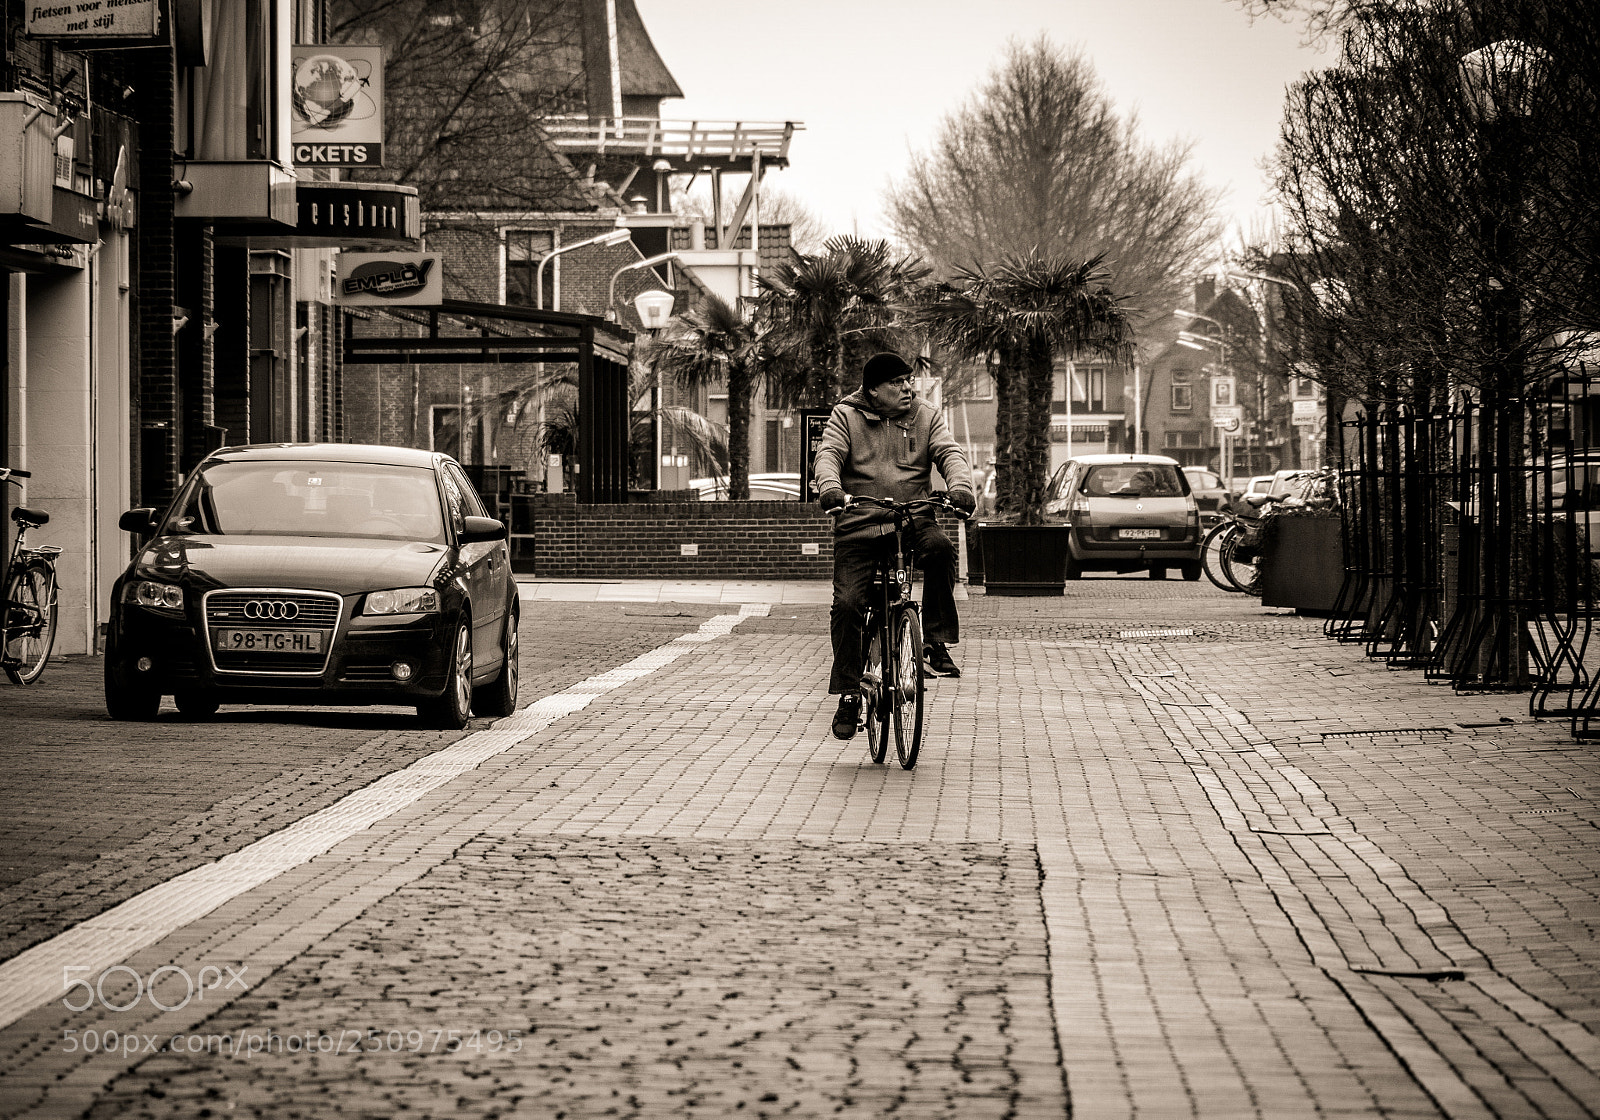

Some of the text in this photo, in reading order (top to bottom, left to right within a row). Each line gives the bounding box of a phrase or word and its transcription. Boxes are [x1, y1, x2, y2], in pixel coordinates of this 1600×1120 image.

[30, 5, 71, 23] fietsen
[75, 1, 102, 13] voor
[66, 13, 114, 32] met stijl
[343, 258, 435, 295] EMPLOY
[233, 632, 316, 650] 98-TG-HL
